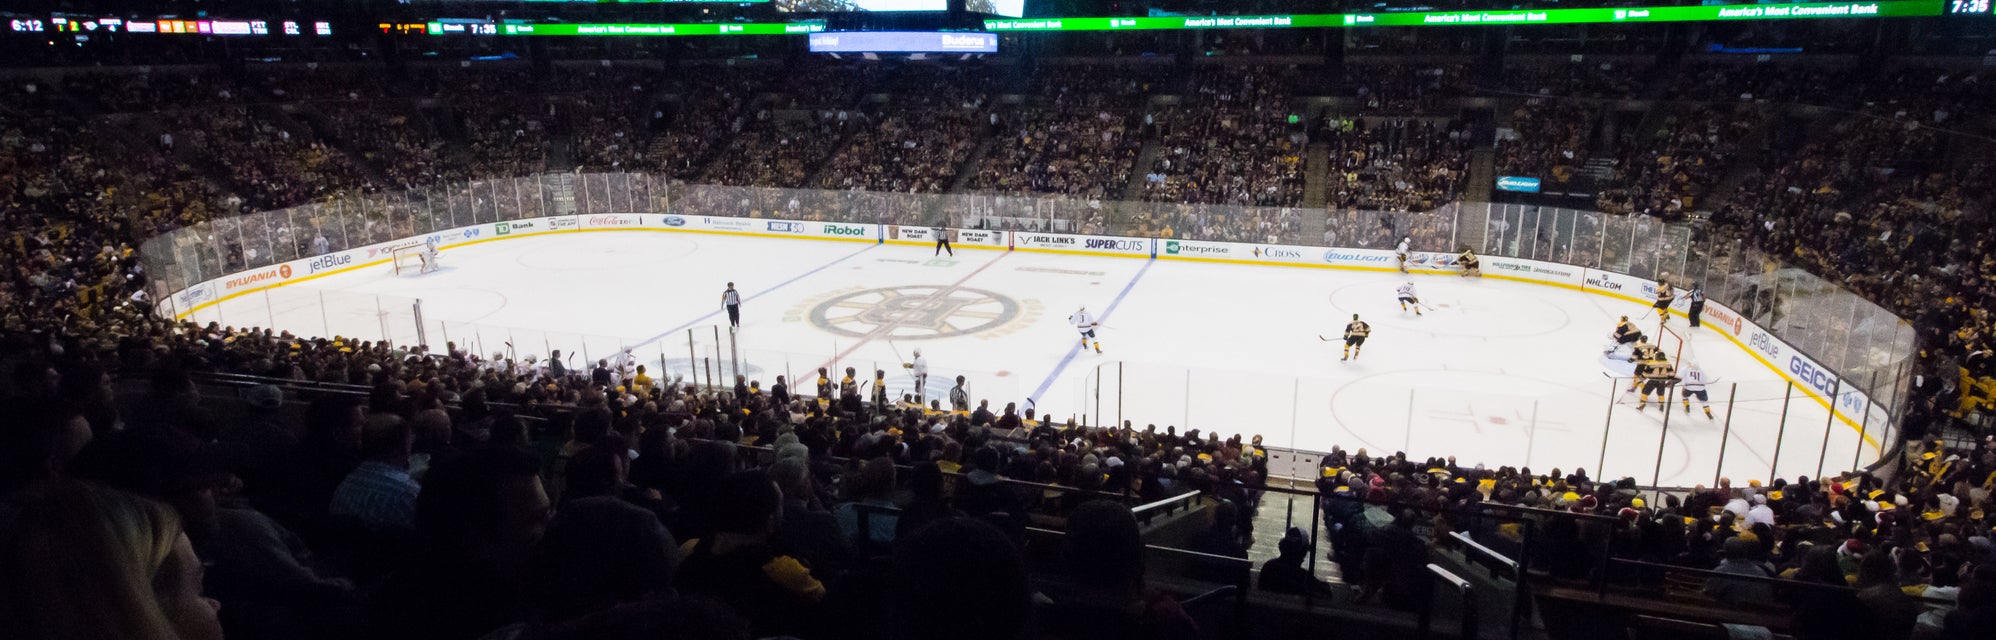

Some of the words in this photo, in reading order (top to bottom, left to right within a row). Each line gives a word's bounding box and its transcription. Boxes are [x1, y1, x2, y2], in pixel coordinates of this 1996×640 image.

[1718, 6, 1763, 18] America's
[1764, 5, 1789, 17] Most
[1790, 4, 1848, 16] Convenient
[1850, 3, 1878, 15] Bank
[1952, 0, 1989, 13] 7:35
[1184, 18, 1216, 27] America's
[1216, 17, 1234, 26] Most
[1234, 17, 1274, 26] Convenient
[1274, 17, 1291, 25] Bank
[1424, 14, 1460, 23] America's
[1461, 13, 1481, 22] Most
[1481, 12, 1526, 22] Convenient
[1527, 12, 1547, 21] Bank
[11, 19, 43, 32] 6:12
[471, 24, 497, 34] 7:35
[497, 223, 510, 235] TD
[512, 222, 534, 230] Bank
[823, 224, 866, 236] iRobot
[1052, 237, 1075, 245] LINK'S
[1085, 238, 1143, 251] SUPERCUTS
[309, 254, 351, 274] jetBlue
[1328, 252, 1354, 261] BUD
[1354, 253, 1391, 263] LIGHT
[225, 270, 277, 289] SYLVANIA
[1586, 278, 1622, 291] NHL.COM
[1703, 304, 1734, 326] YLVANIA
[1749, 329, 1779, 359] jetBlue
[1690, 371, 1700, 381] 41
[1790, 355, 1837, 399] GEICO
